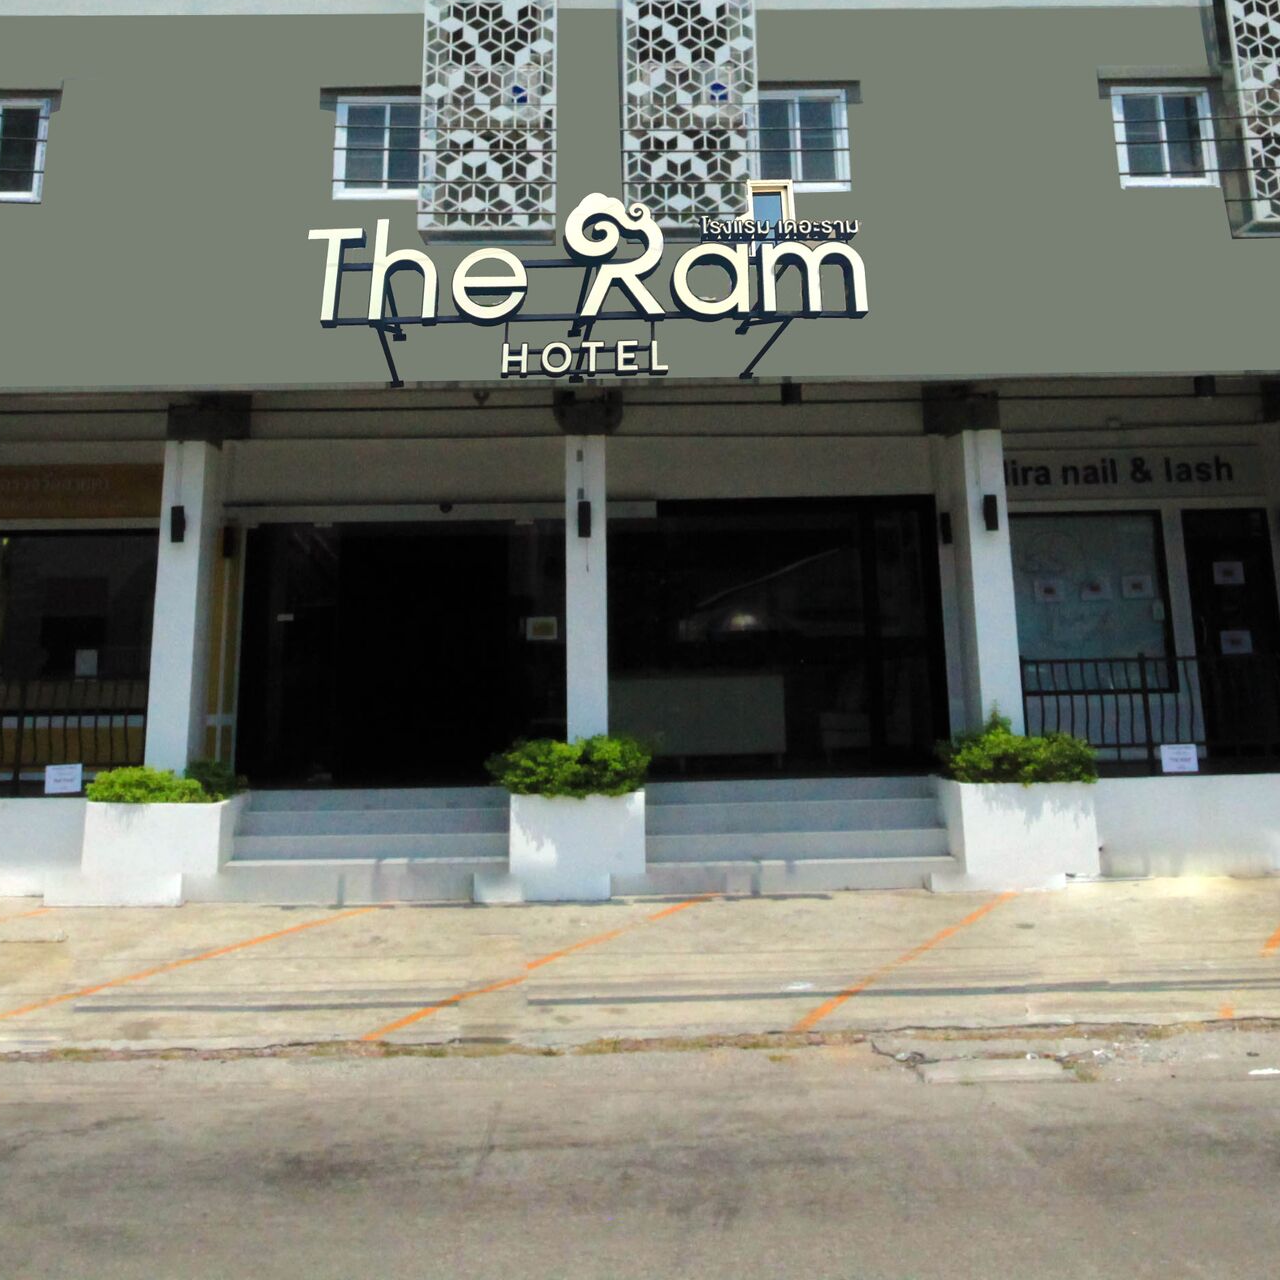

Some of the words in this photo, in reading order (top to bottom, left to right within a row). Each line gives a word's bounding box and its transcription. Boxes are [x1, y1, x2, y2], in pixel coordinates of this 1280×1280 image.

[701, 216, 770, 235] โรงแรม
[778, 218, 860, 235] เดอะราม
[308, 219, 528, 323] The
[565, 192, 869, 318] Ram
[501, 340, 669, 376] HOTEL
[1062, 458, 1118, 485] nail
[1129, 456, 1153, 483] &
[1164, 455, 1234, 483] lash
